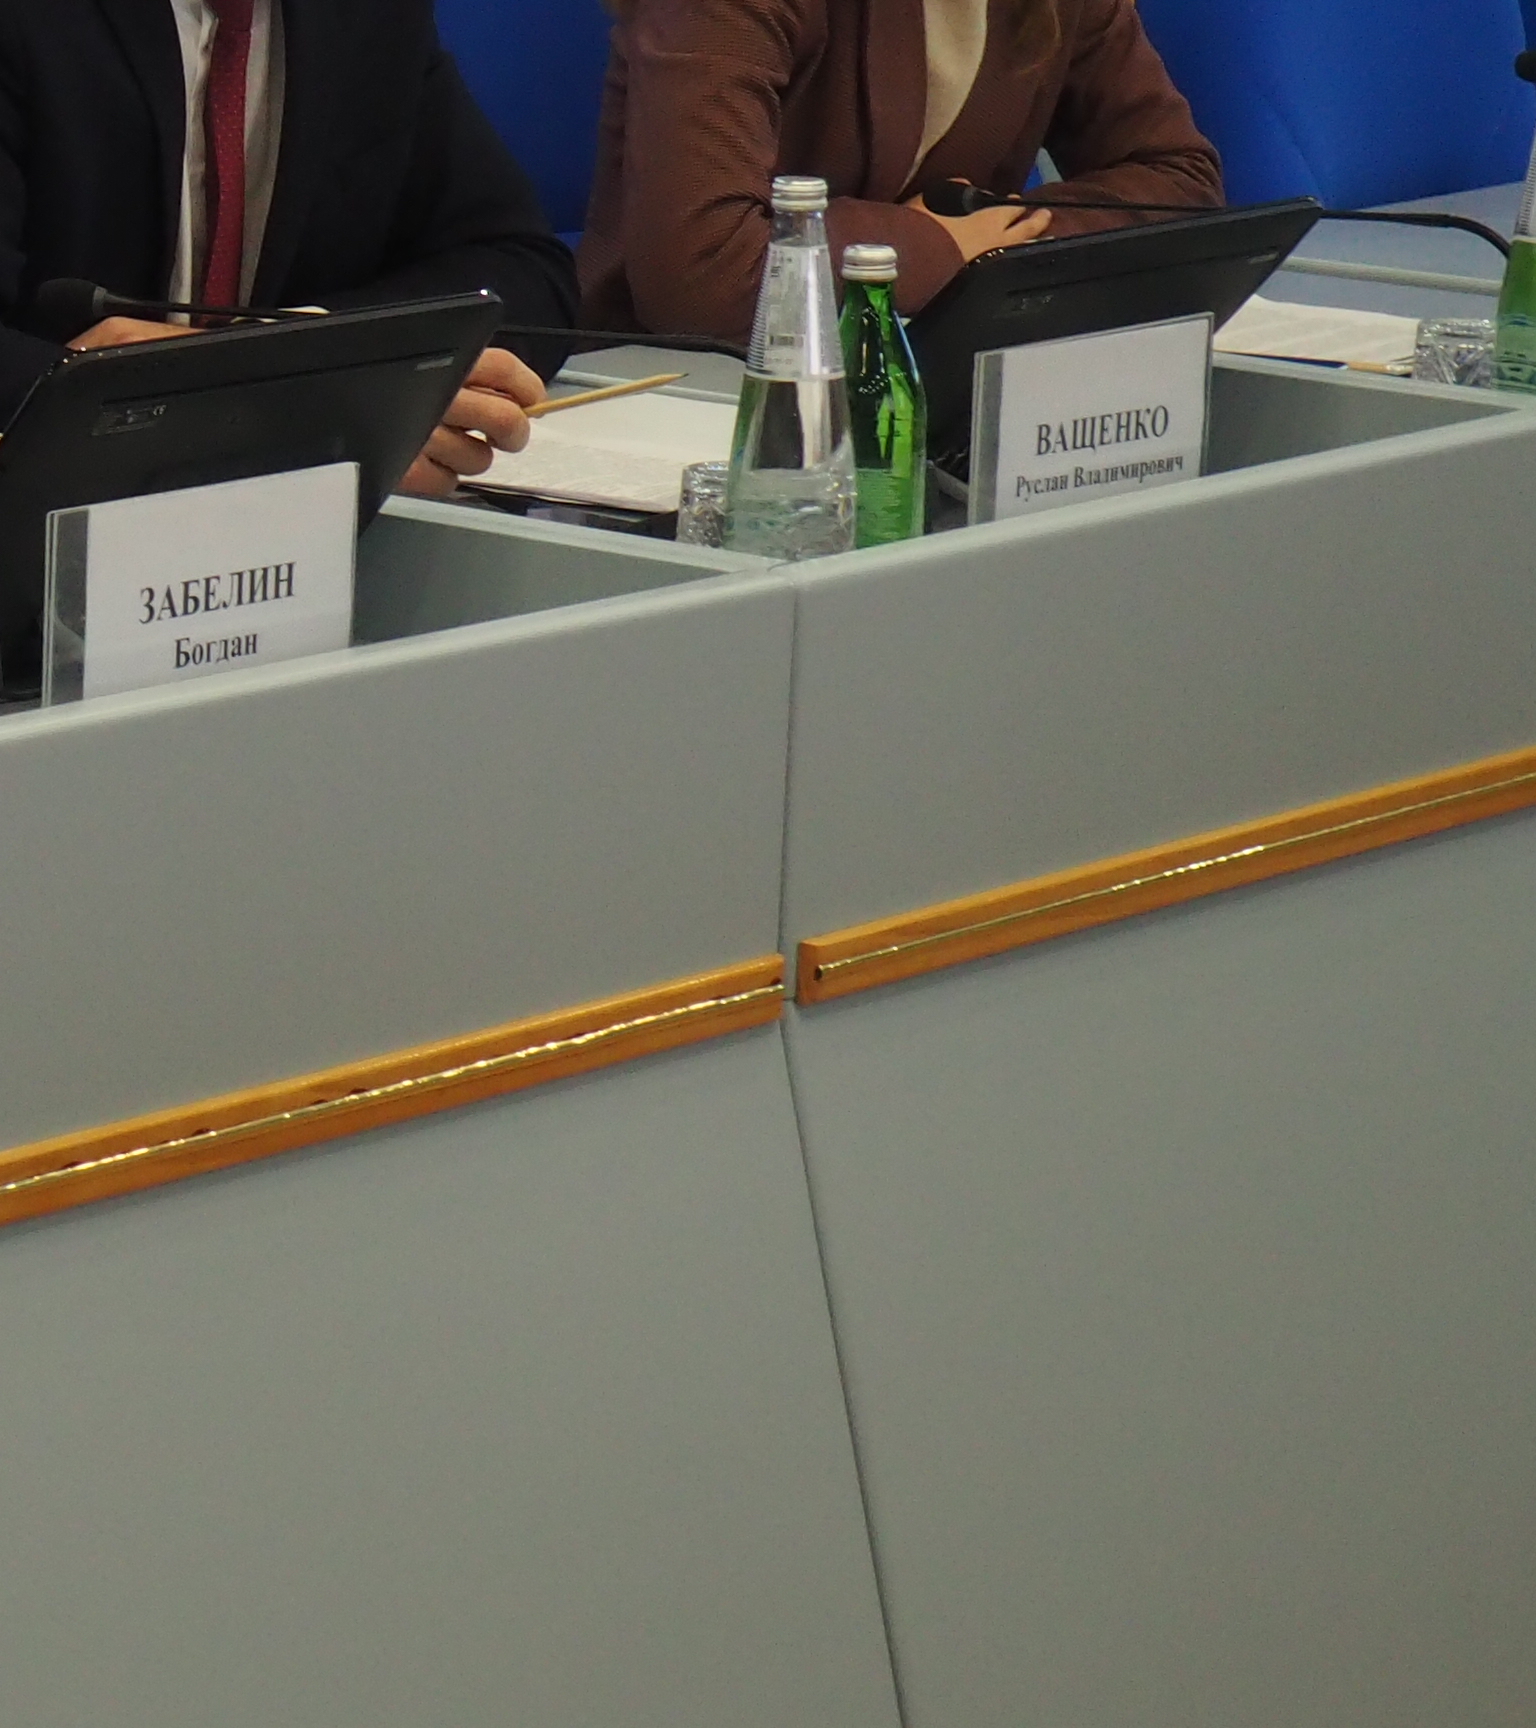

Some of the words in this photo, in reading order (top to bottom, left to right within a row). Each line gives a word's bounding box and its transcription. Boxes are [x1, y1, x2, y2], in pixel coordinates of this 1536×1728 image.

[1035, 405, 1170, 456] ВАЩЕНКО
[1015, 474, 1069, 502] Руслан
[1073, 456, 1184, 488] Владимирович
[138, 561, 297, 624] ЗАБЕЛИН
[174, 633, 259, 668] Богдан
